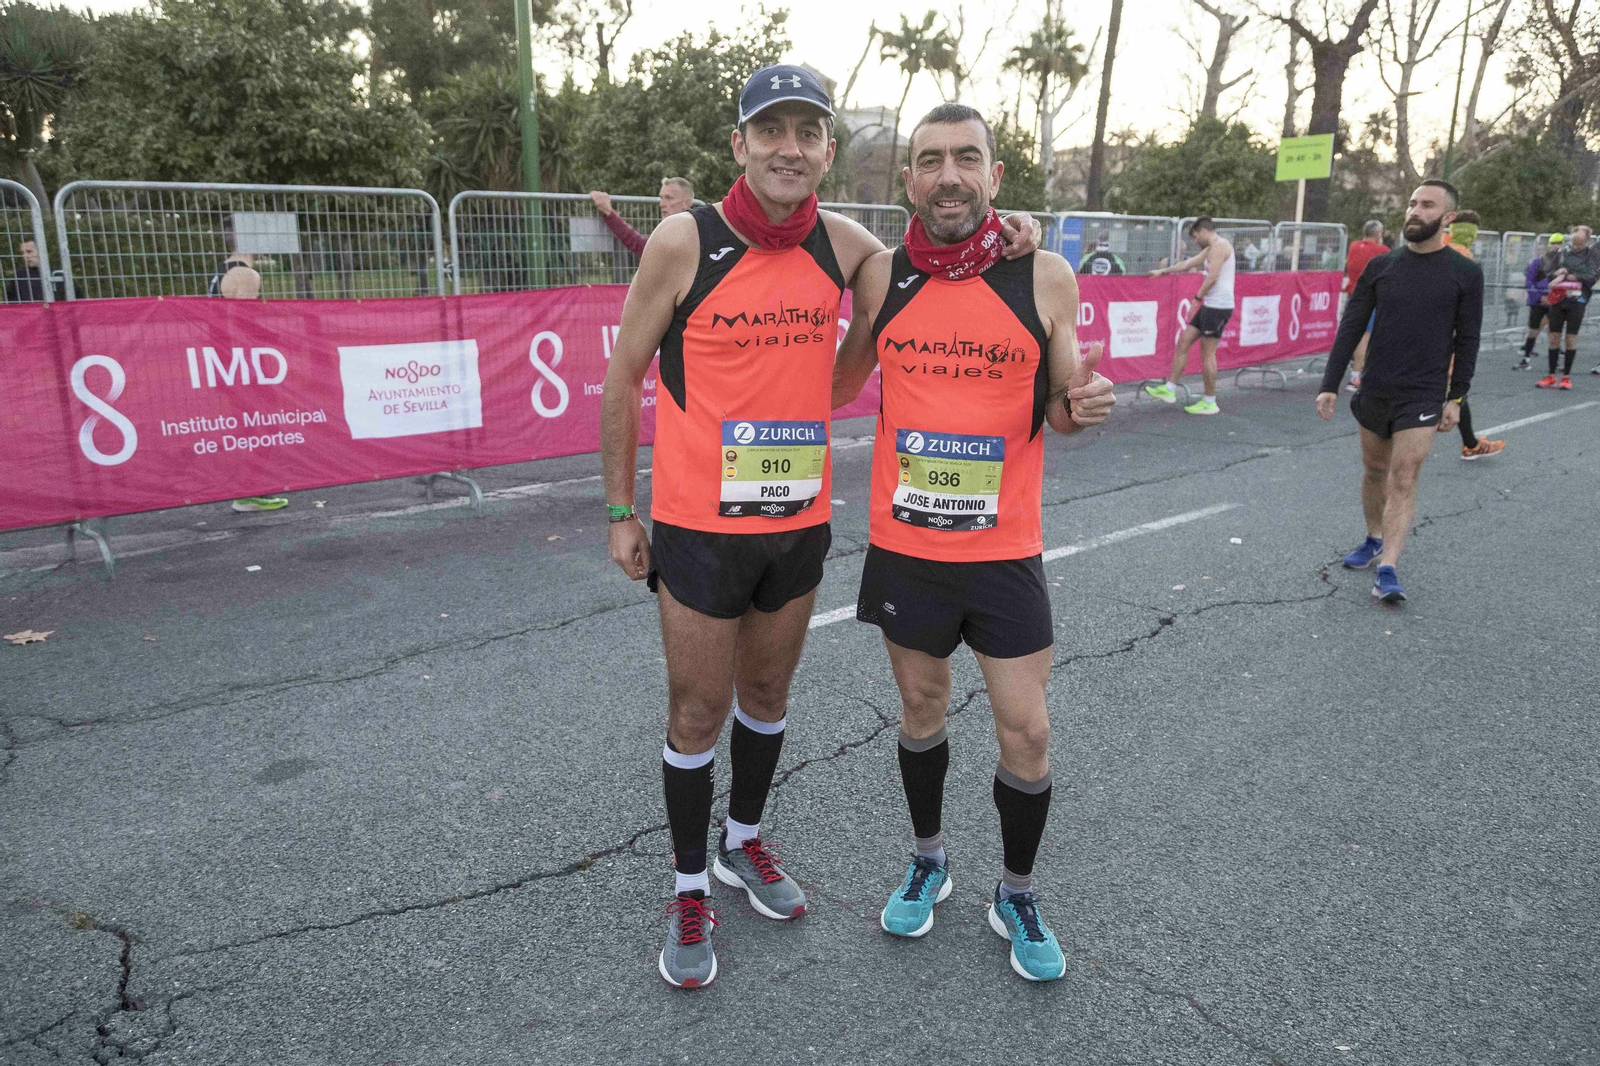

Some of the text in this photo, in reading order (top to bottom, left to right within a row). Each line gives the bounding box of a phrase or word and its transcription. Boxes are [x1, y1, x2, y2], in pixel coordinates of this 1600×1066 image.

[735, 332, 824, 347] viajes
[186, 346, 288, 388] IMD
[902, 363, 1003, 379] viajes
[368, 384, 462, 401] AYUNTAMIENTO
[383, 400, 448, 415] DE SEVILLA
[161, 409, 327, 436] Instituto Municipal
[759, 427, 815, 441] ZURICH
[194, 430, 305, 456] de Deportes
[927, 438, 990, 456] ZURICH
[761, 459, 792, 474] 910
[927, 470, 961, 487] 936
[760, 486, 790, 498] PACO
[903, 492, 986, 511] JOSE ANTONIO
